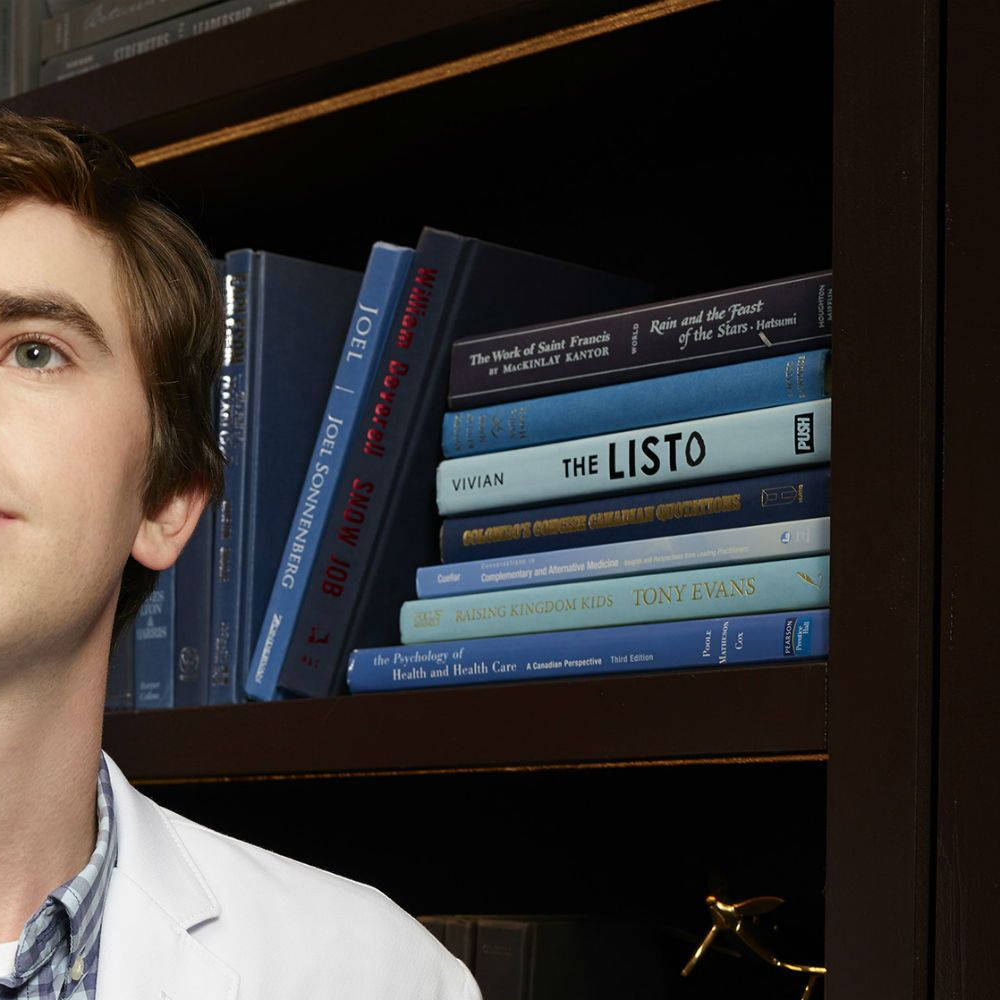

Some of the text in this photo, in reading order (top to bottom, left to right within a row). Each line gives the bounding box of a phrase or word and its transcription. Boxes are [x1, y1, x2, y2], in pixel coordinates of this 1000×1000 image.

[346, 302, 379, 362] JOEL
[650, 300, 764, 336] Rain and the Feast
[679, 312, 797, 351] of the Stars Hatsumi
[470, 331, 611, 367] The Work of Saint Francis
[565, 346, 610, 364] KANTOR
[631, 322, 640, 355] WORLD
[319, 414, 344, 457] JOEL
[321, 267, 439, 598] William Deverell SNOW JOB
[797, 416, 812, 451] PUSH
[452, 473, 505, 492] VIVIAN
[563, 455, 599, 478] THE
[281, 462, 330, 590] SONNENBERG
[481, 558, 620, 584] Complementary and Alternative Medicine
[455, 605, 507, 623] RAISING
[511, 599, 577, 617] KINGDOM
[580, 594, 614, 611] KIDS
[633, 584, 686, 607] TONY
[691, 577, 756, 600] EVANS
[784, 619, 793, 655] PEARSON
[373, 647, 464, 668] the Psychology of
[392, 667, 424, 681] Health
[427, 665, 449, 679] and
[453, 661, 489, 677] Health
[491, 659, 517, 674] Care
[533, 660, 562, 671] Canadian
[564, 658, 602, 671] Perspective
[611, 654, 629, 665] Third
[630, 653, 654, 664] Edition
